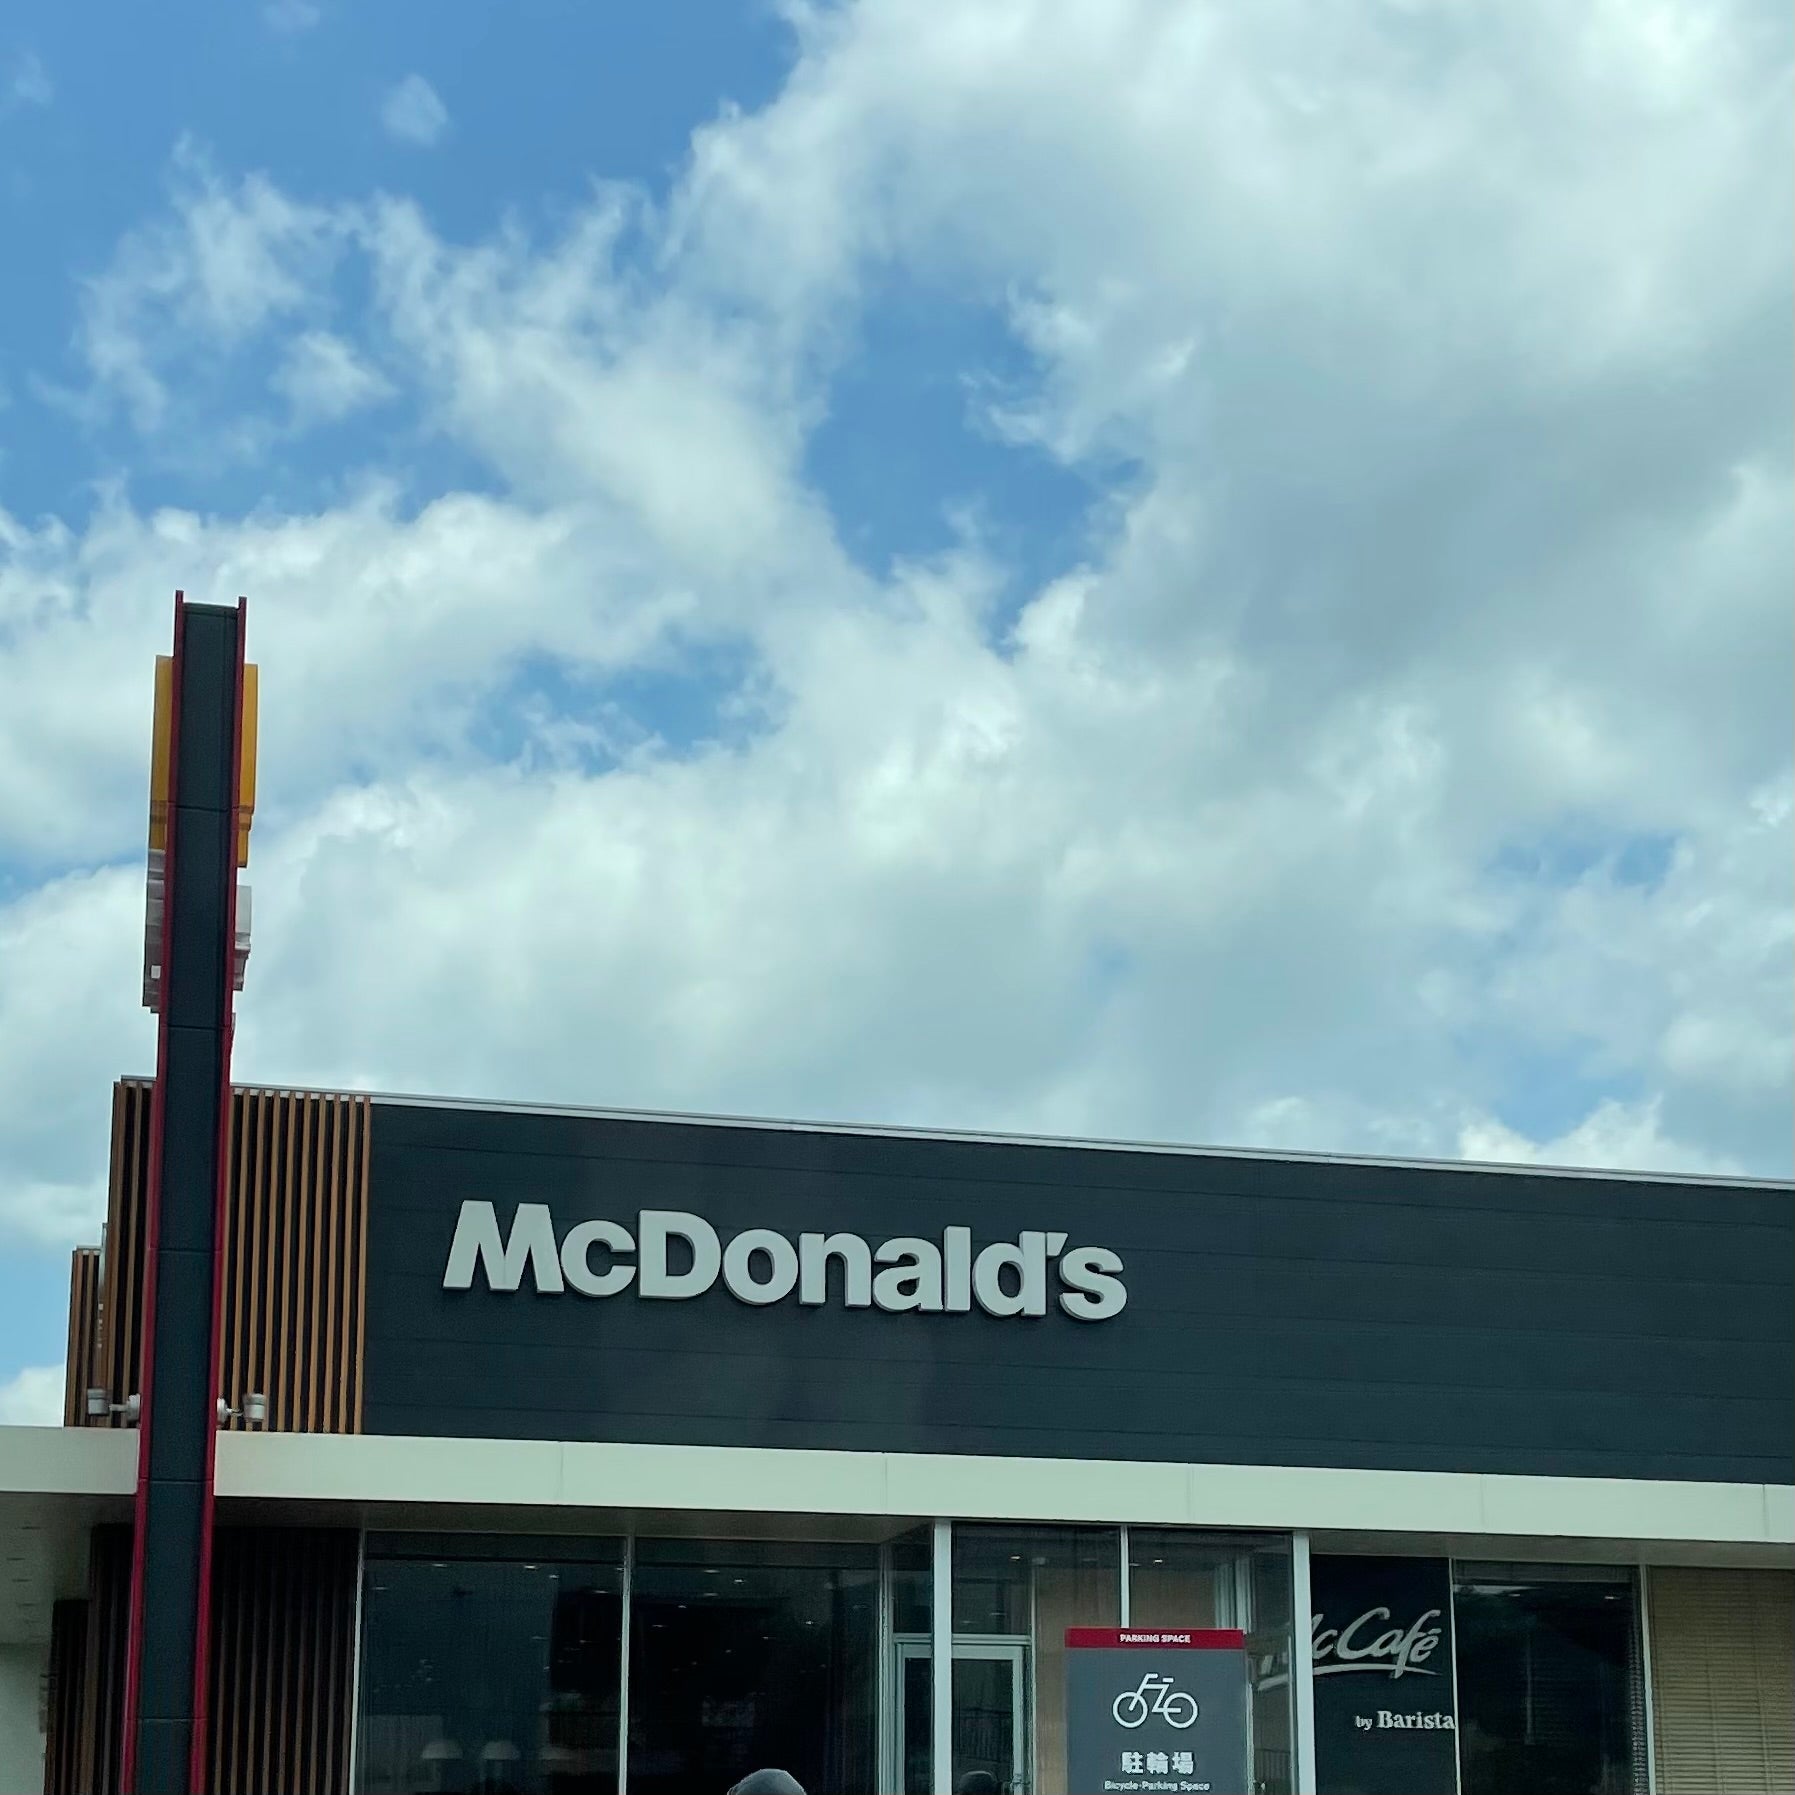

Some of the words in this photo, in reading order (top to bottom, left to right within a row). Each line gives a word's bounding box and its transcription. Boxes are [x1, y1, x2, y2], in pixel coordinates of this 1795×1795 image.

[443, 1200, 1127, 1320] McDonald's
[1120, 1634, 1159, 1643] PARKING
[1161, 1634, 1191, 1643] SPACE
[1312, 1607, 1441, 1678] cCafé
[1355, 1716, 1373, 1731] by
[1377, 1711, 1456, 1730] Barista
[1122, 1752, 1194, 1774] 駐輪場
[1180, 1781, 1210, 1792] Space
